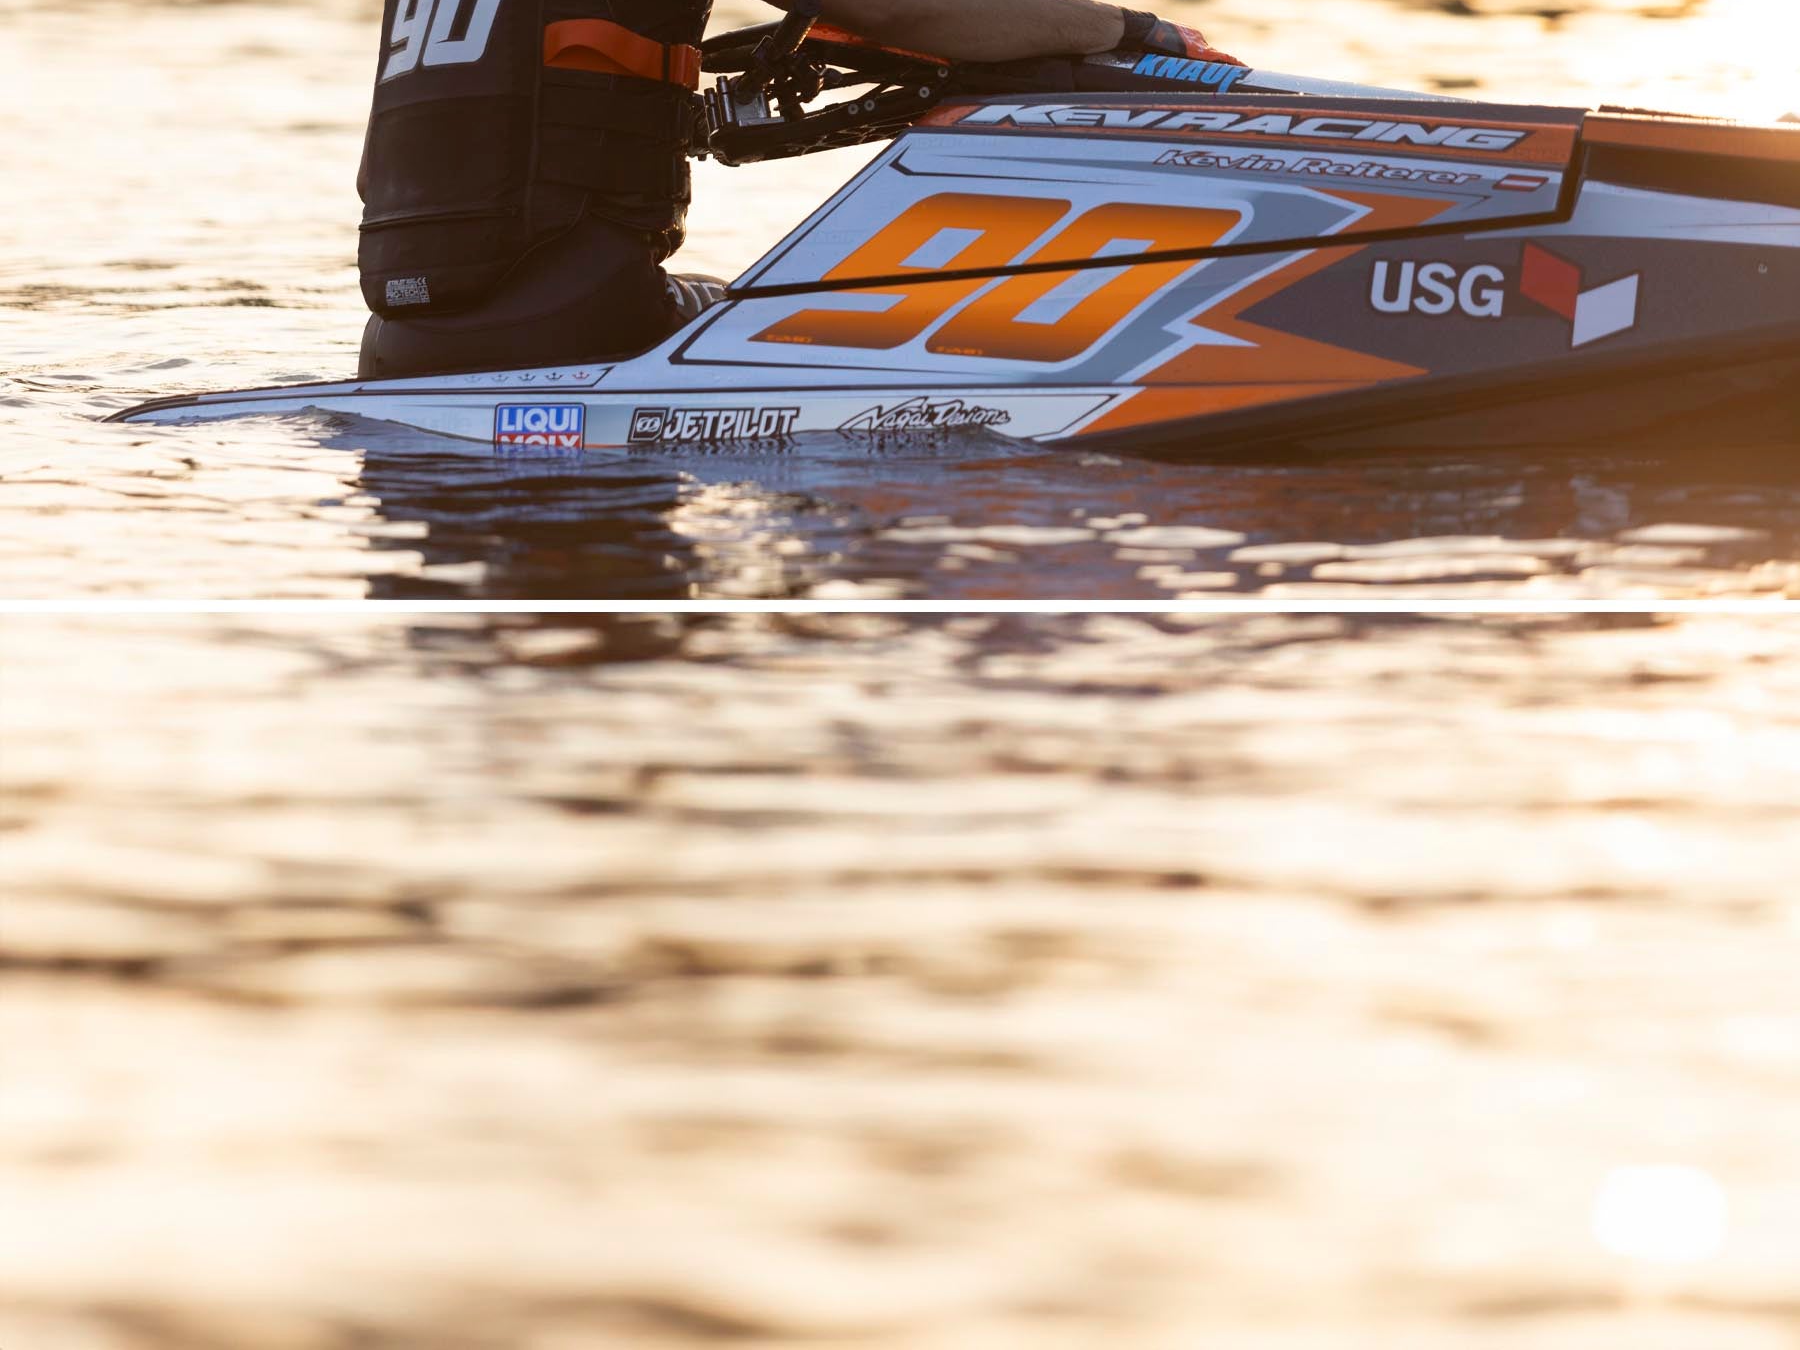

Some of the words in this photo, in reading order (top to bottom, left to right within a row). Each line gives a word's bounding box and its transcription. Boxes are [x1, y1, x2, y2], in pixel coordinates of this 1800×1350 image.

[1132, 53, 1252, 95] KNAUF
[957, 104, 1528, 150] KEVRACING
[1153, 149, 1286, 172] Kevin
[1288, 157, 1483, 186] Reiterer
[747, 191, 1244, 364] 90
[1370, 261, 1505, 318] USG
[501, 407, 580, 433] LIQUI
[662, 408, 799, 441] JETPILOT
